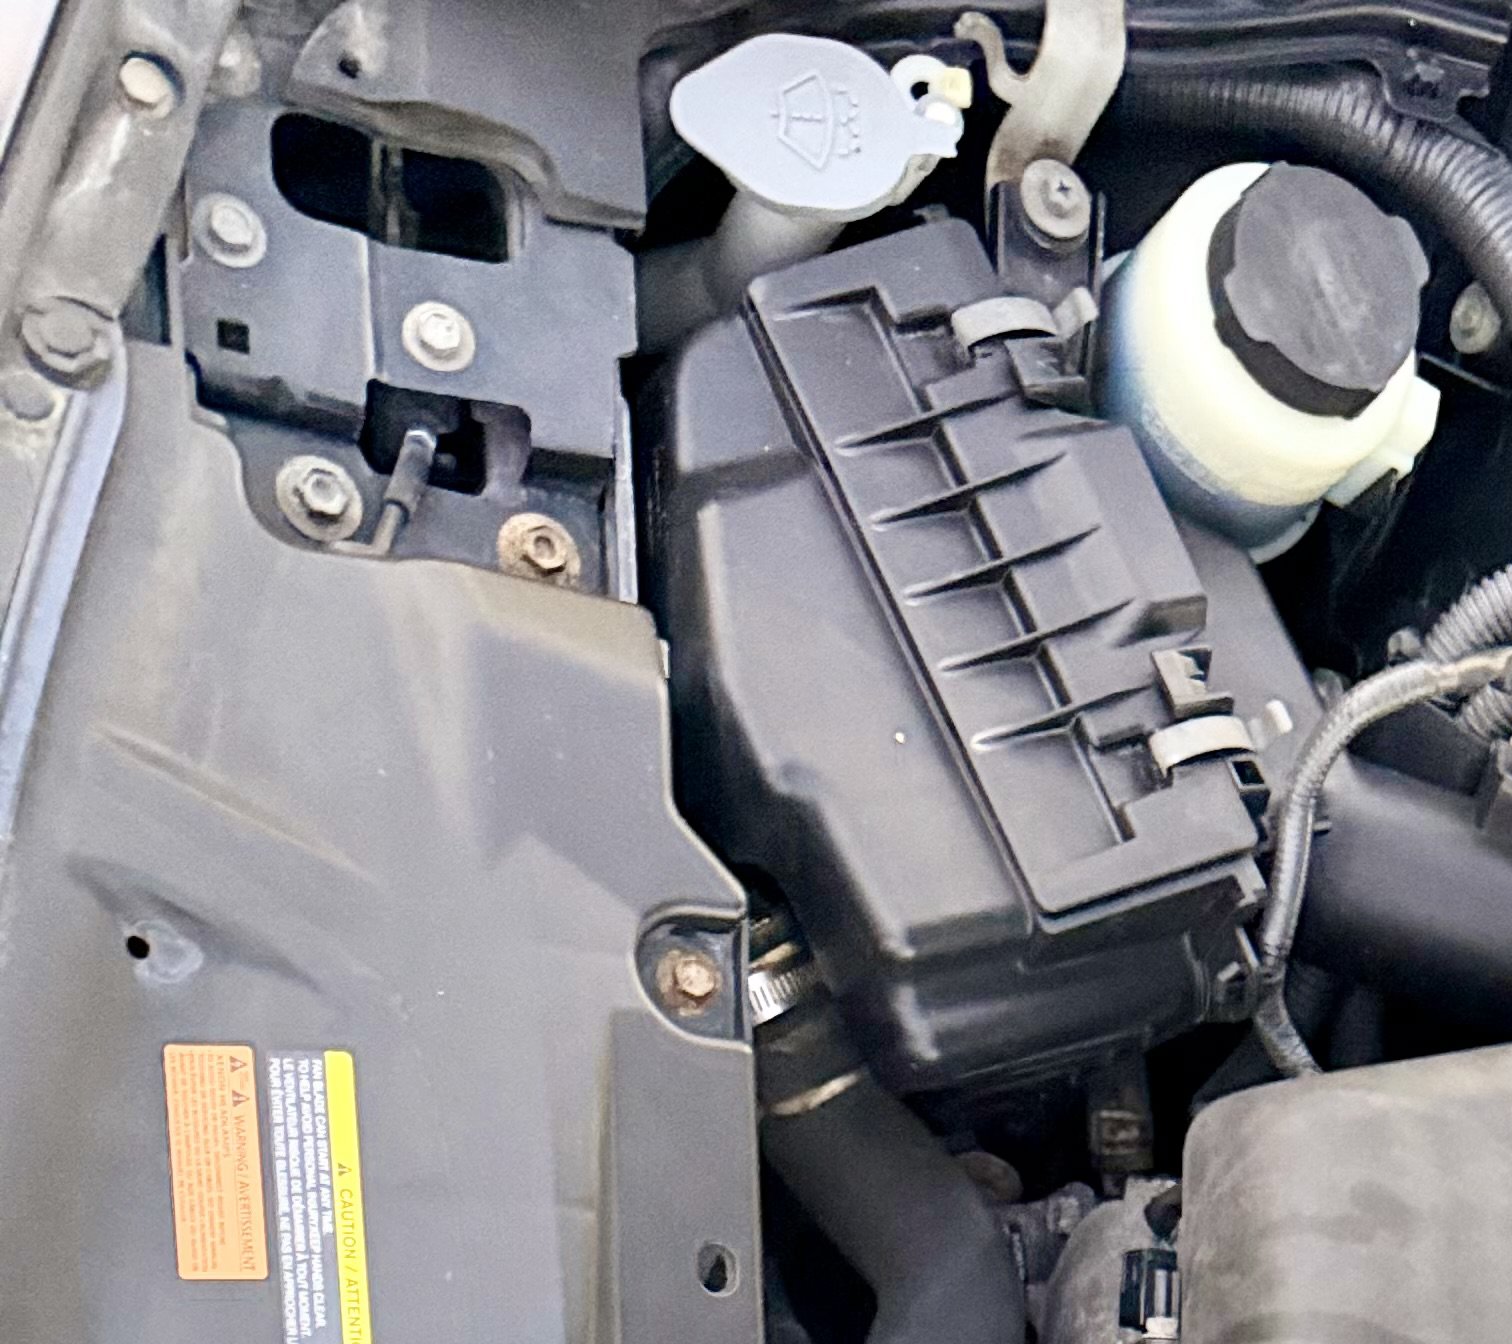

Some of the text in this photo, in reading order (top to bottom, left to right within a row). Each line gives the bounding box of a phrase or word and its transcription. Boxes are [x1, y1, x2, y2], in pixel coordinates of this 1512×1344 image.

[269, 1058, 282, 1088] POUR
[282, 1058, 294, 1071] LE
[298, 1059, 309, 1074] TO
[312, 1059, 322, 1080] FAN
[299, 1075, 310, 1102] HELP
[312, 1081, 324, 1113] BLADE
[271, 1089, 284, 1123] ÉVITER
[284, 1072, 298, 1138] VENTILATEUR
[301, 1103, 313, 1134] AVOID
[274, 1125, 286, 1157] TOUTE
[314, 1115, 326, 1138] CAN
[234, 1115, 247, 1171] WARNING
[317, 1140, 329, 1171] START
[288, 1139, 301, 1178] RISQUE
[303, 1136, 316, 1190] PERSONAL
[291, 1180, 302, 1193] DE
[319, 1172, 330, 1184] AT
[320, 1187, 332, 1208] ANY
[238, 1181, 256, 1272] AVERTISSEMENT
[280, 1217, 290, 1231] NE
[292, 1196, 306, 1251] DÉMARRER
[339, 1188, 356, 1259] CAUTION
[280, 1233, 291, 1253] PAS
[282, 1255, 293, 1270] EN
[297, 1263, 309, 1289] TOUT
[312, 1255, 324, 1290] HANDS
[345, 1265, 358, 1274] /
[283, 1270, 297, 1336] APPROCHER
